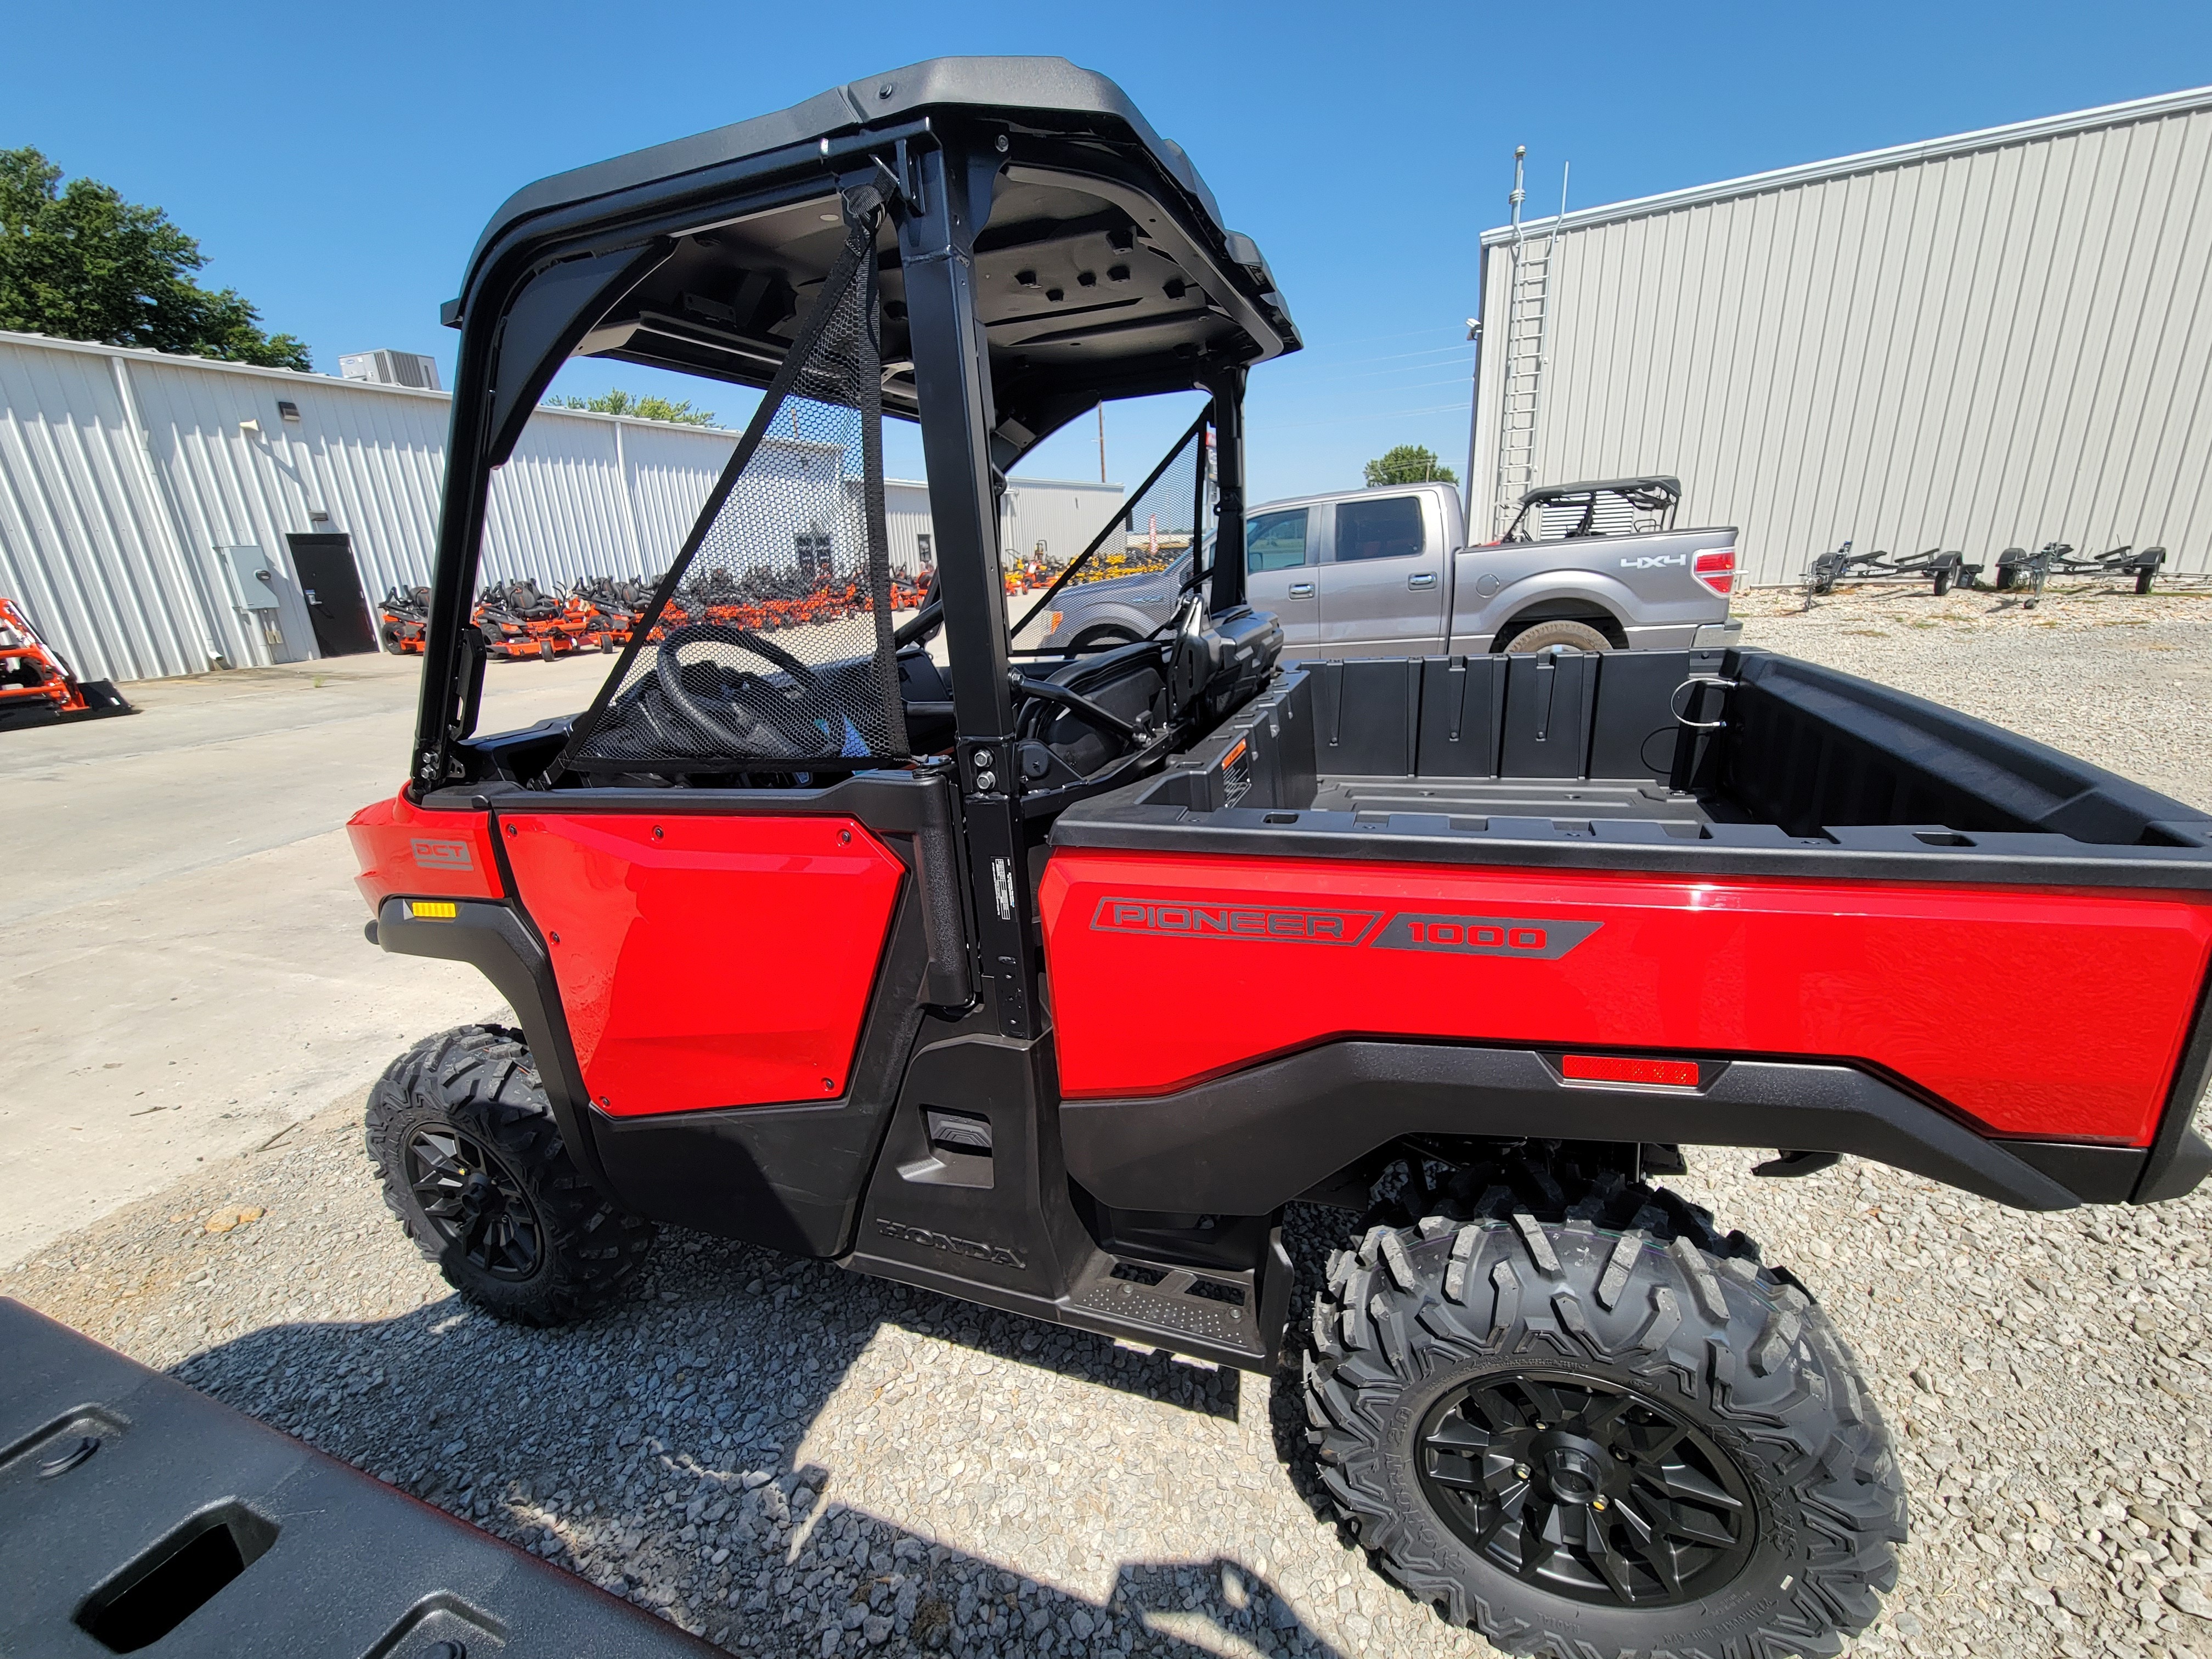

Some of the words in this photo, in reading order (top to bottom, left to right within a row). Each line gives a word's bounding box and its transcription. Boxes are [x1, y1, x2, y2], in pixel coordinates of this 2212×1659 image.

[1620, 554, 1686, 569] 4X4
[415, 843, 464, 858] DCT
[1114, 904, 1344, 939] PIONEER
[1408, 922, 1548, 950] 1000
[876, 1217, 1027, 1270] HONDA
